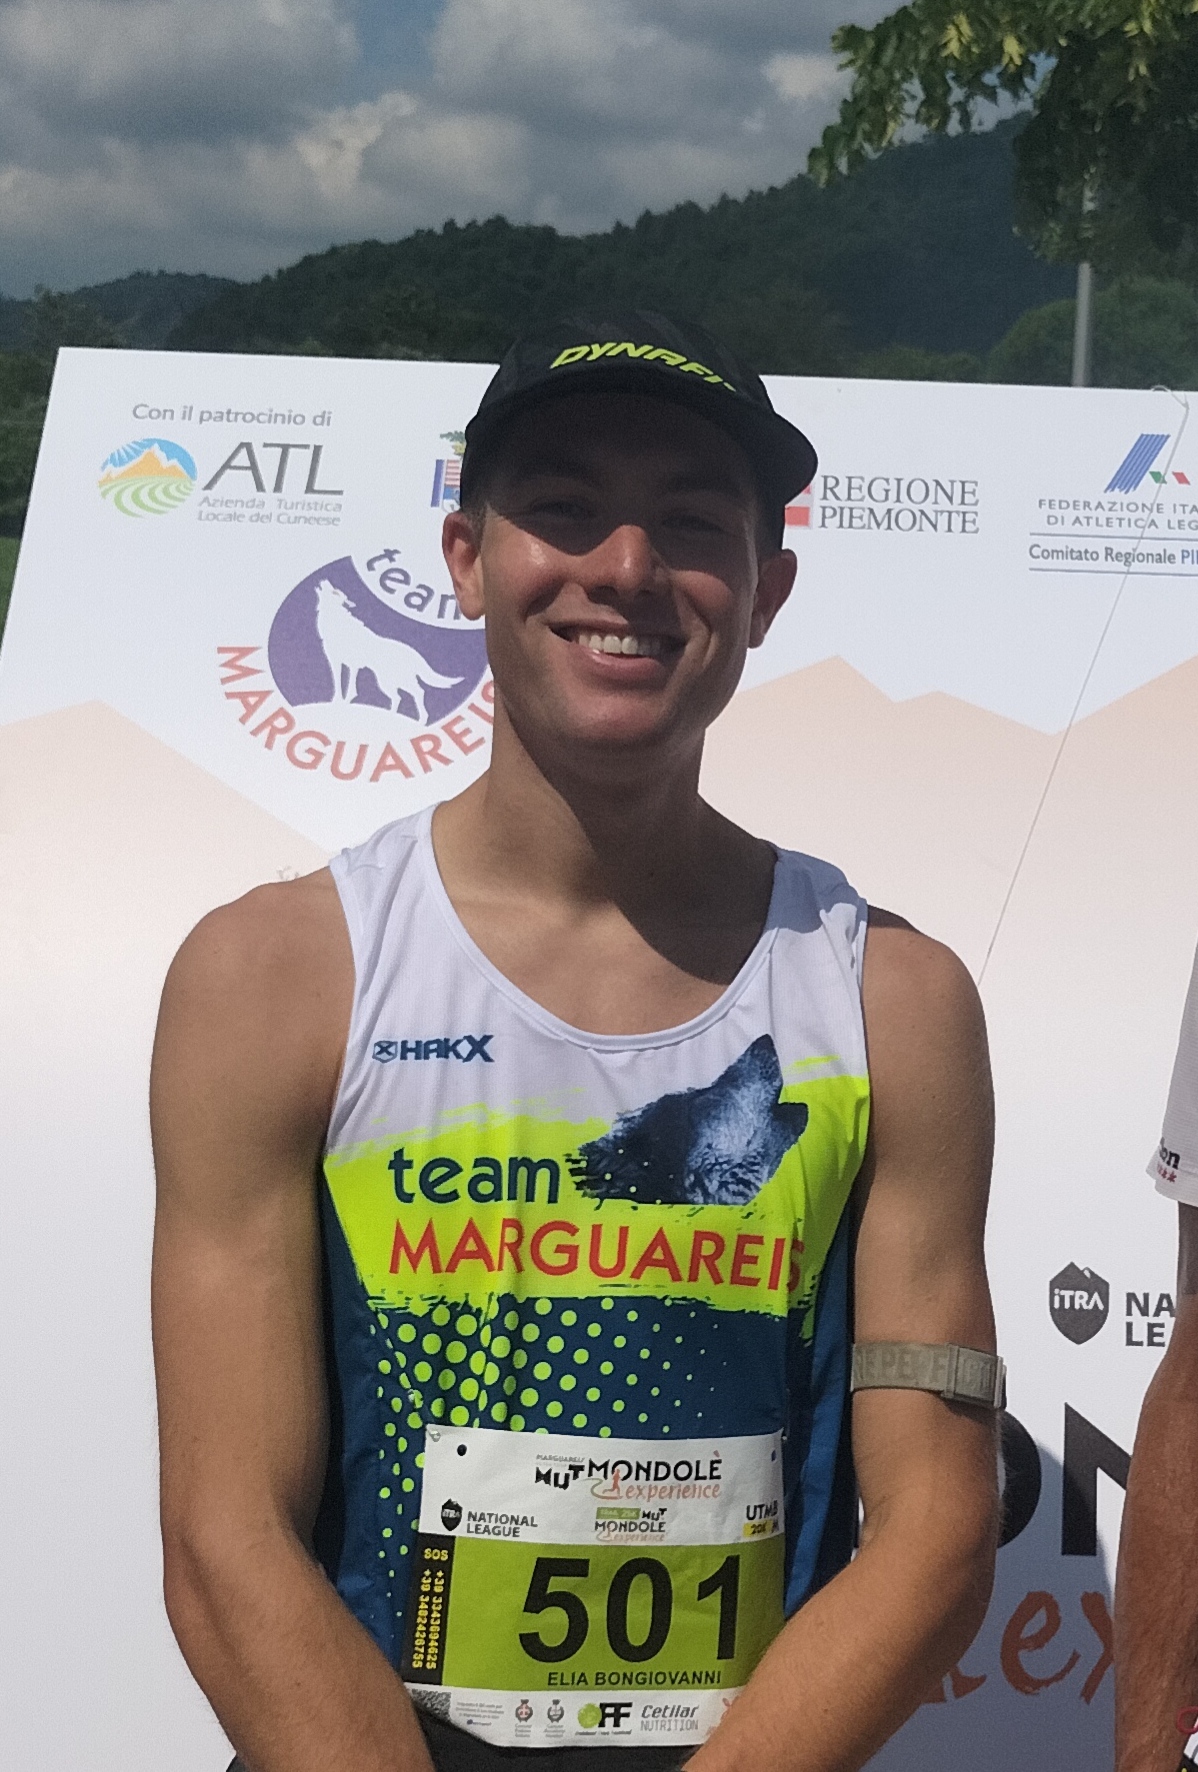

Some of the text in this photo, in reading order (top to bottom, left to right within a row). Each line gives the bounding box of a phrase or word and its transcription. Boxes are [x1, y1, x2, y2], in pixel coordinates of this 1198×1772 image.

[133, 403, 333, 427] Con il patrocinio di
[202, 441, 344, 496] ATL
[820, 474, 980, 508] REGIONE
[198, 496, 343, 513] Azienda Turistica
[1038, 499, 1165, 514] FEDERAZIONE
[197, 511, 341, 526] Locale del Cuneese
[818, 505, 980, 534] PIEMONTE
[1047, 515, 1065, 526] DI
[1072, 516, 1159, 529] ATLETICA
[1029, 544, 1099, 562] Comitato
[1104, 546, 1176, 567] Regionale
[388, 1147, 559, 1204] team
[389, 1217, 804, 1292] MARGUAREIS
[1125, 1292, 1176, 1318] NA
[1125, 1321, 1166, 1347] LE
[535, 1450, 722, 1490] MUT MONDOLÈ
[625, 1483, 721, 1502] experience
[466, 1523, 520, 1538] LEAGUE
[467, 1511, 538, 1527] NATIONAL
[423, 1547, 449, 1561] SOS
[519, 1555, 740, 1663] 501
[548, 1670, 721, 1686] ELIA BONGIOVANNI
